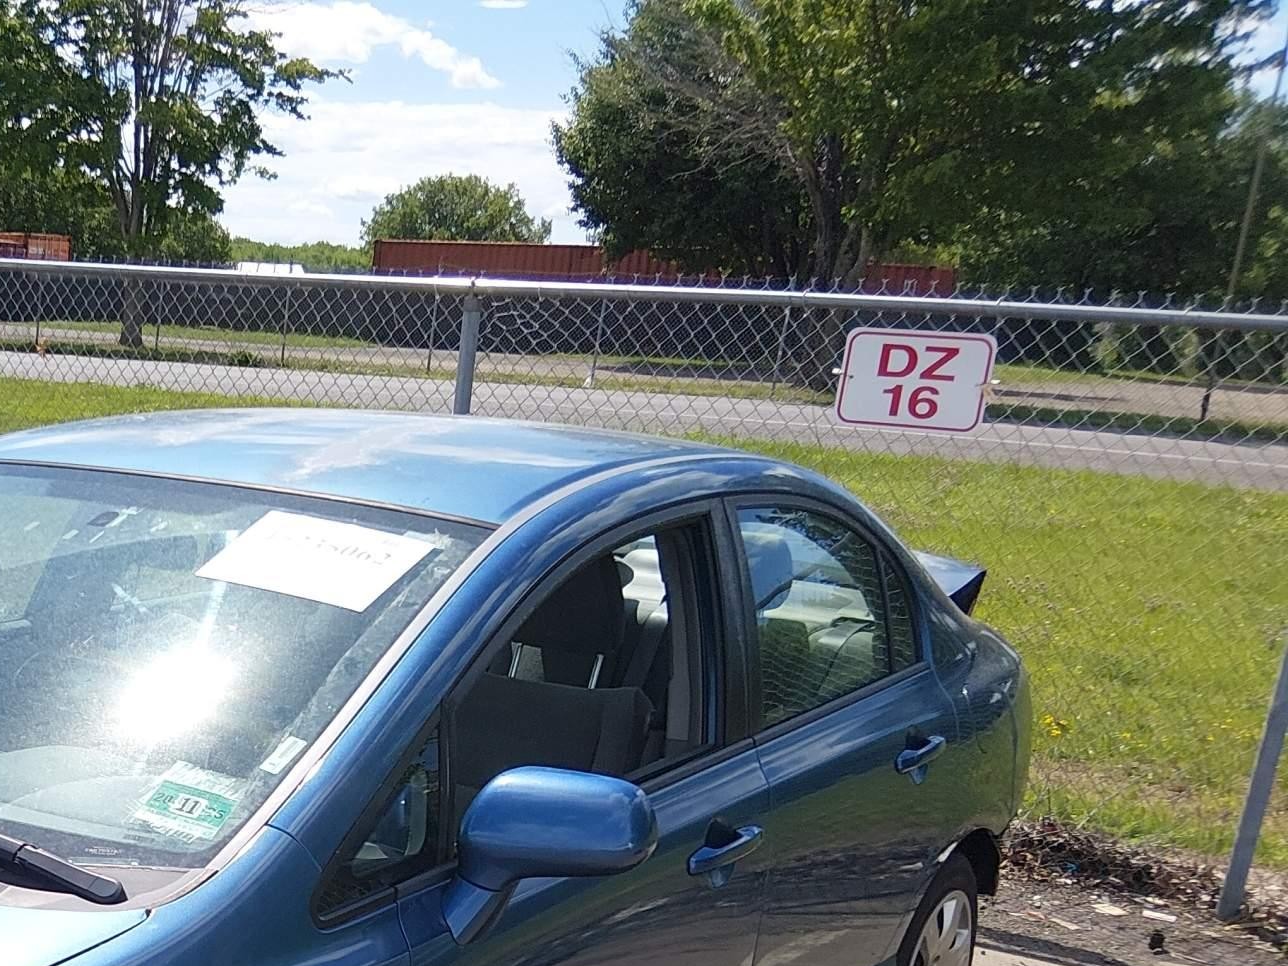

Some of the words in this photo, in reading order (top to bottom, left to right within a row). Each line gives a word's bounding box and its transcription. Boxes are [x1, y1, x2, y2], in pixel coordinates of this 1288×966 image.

[877, 343, 960, 382] DZ
[883, 384, 940, 420] 16
[175, 798, 200, 815] 11
